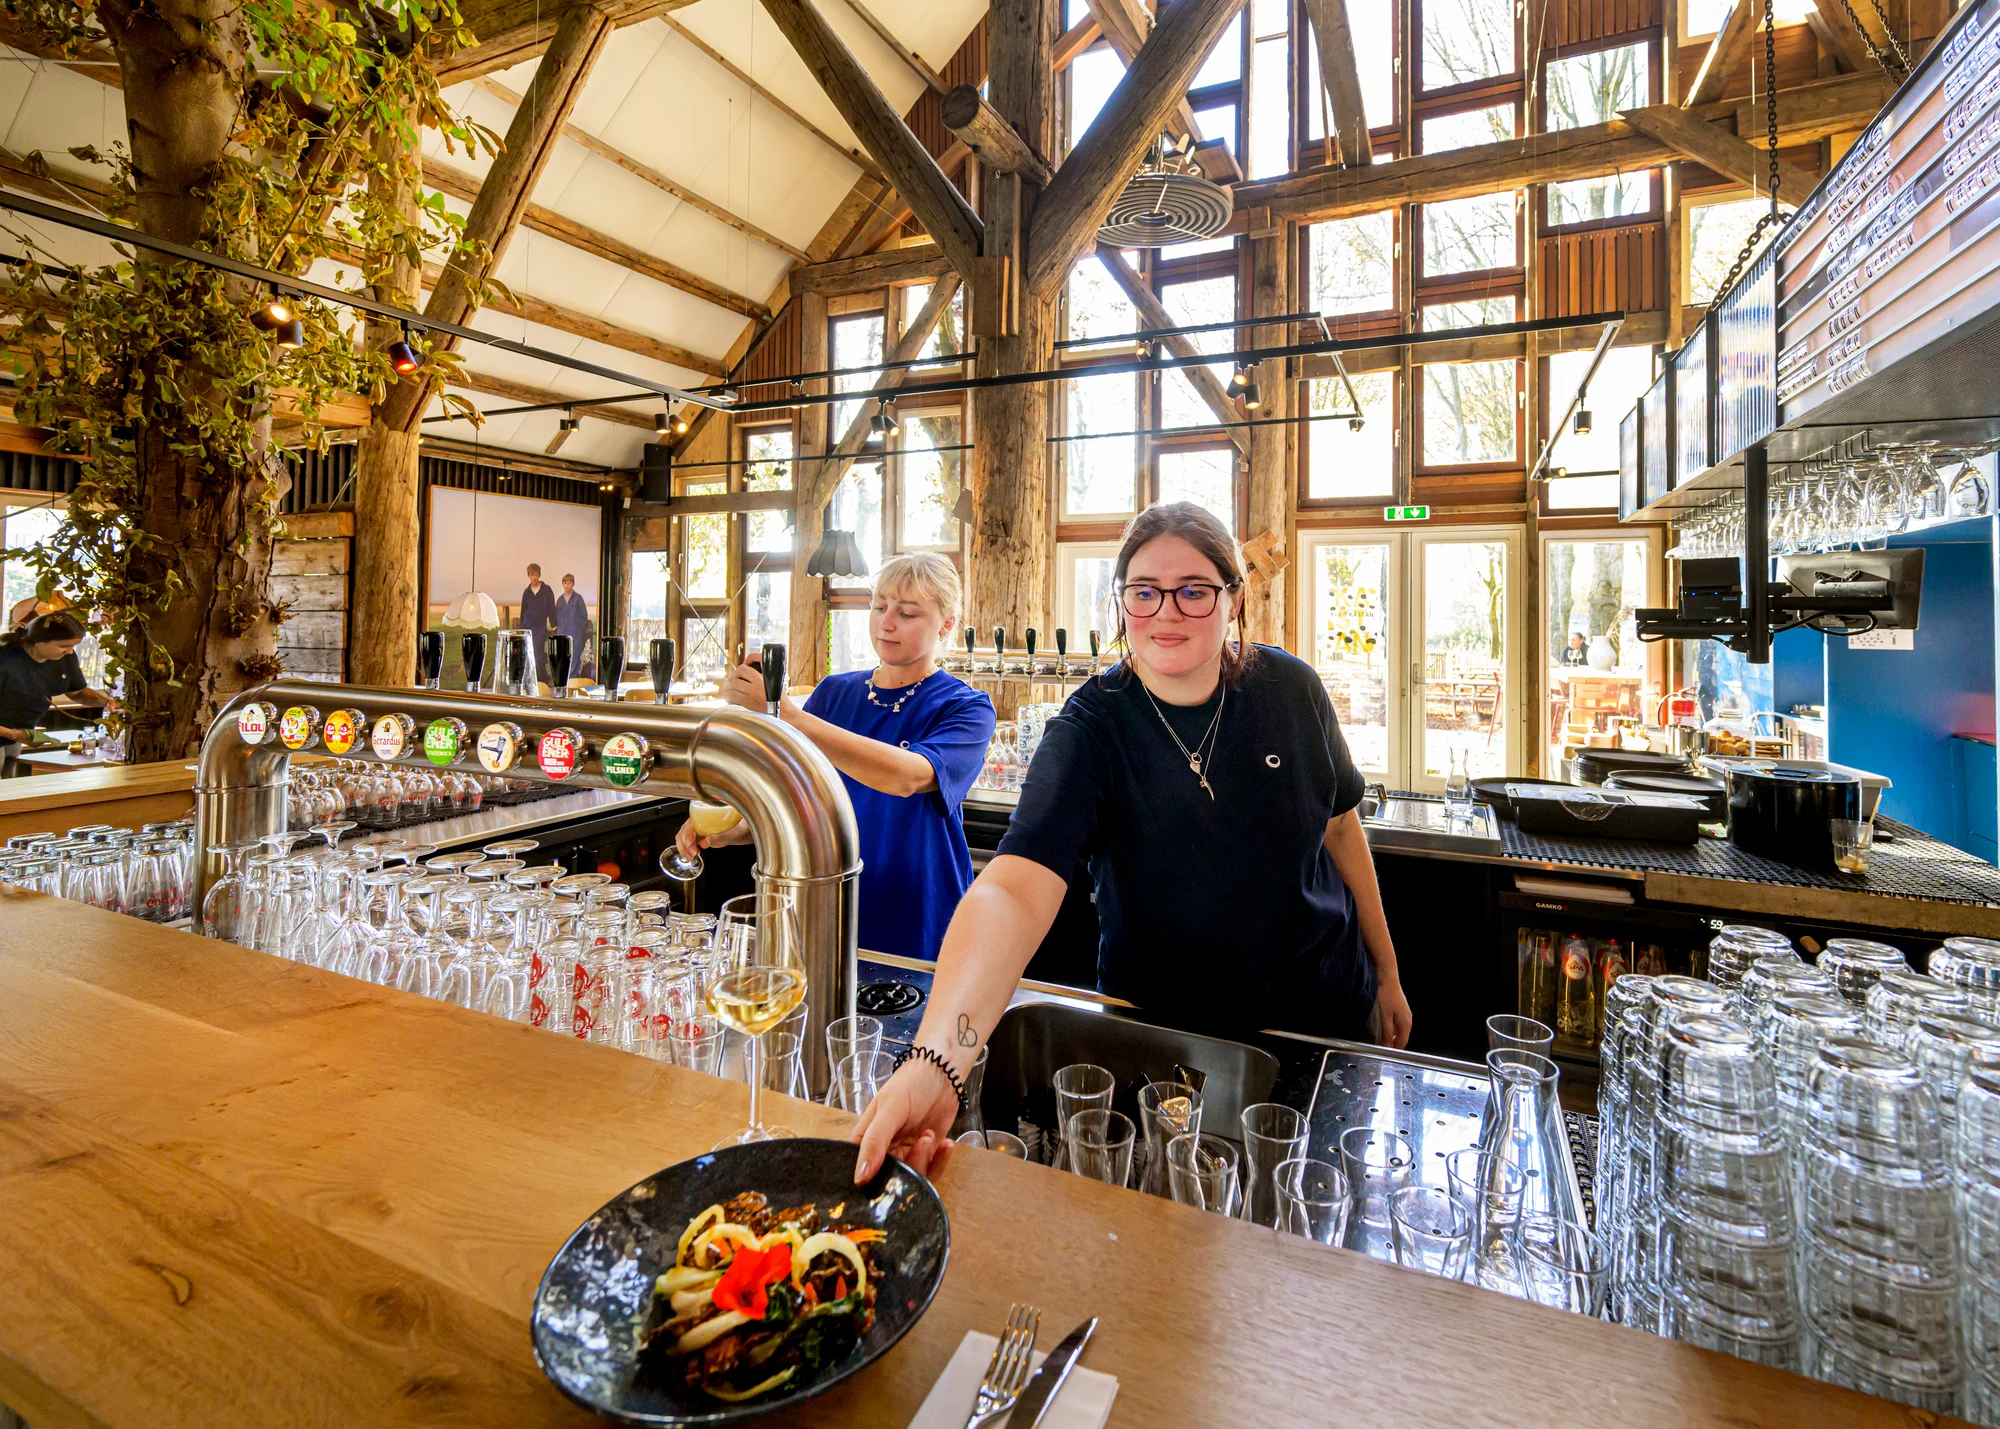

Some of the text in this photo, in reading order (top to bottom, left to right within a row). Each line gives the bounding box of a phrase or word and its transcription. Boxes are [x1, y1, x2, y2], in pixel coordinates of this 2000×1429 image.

[542, 736, 569, 748] GULP
[541, 745, 570, 758] ENER
[607, 748, 635, 757] GULPENER
[605, 765, 635, 775] PILSNER
[1568, 964, 1584, 972] SPA
